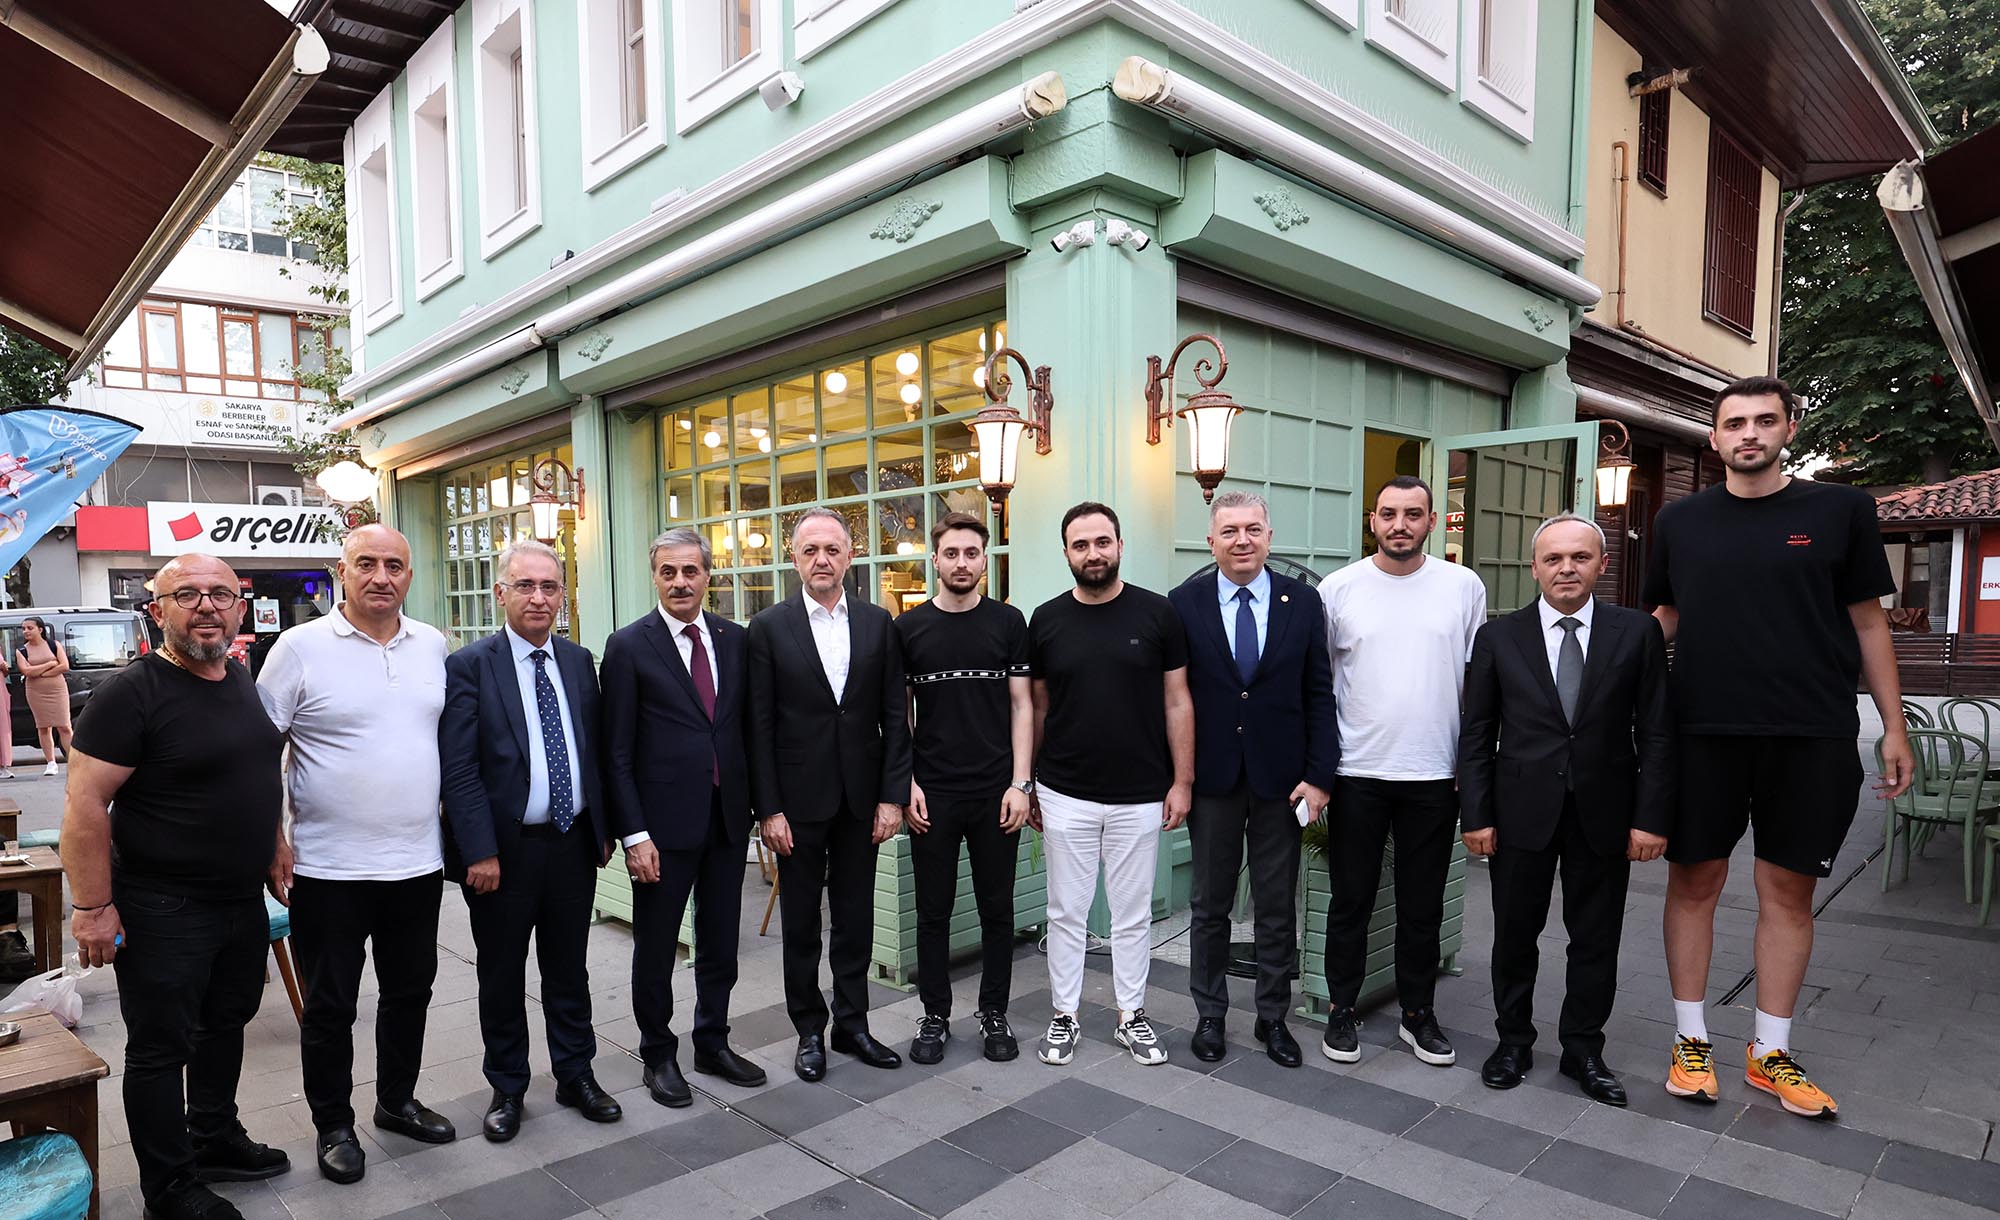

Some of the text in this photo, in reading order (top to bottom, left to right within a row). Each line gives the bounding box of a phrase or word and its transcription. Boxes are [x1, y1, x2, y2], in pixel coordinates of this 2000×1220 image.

[225, 402, 262, 411] SAKARYA
[222, 412, 266, 421] BERBERLER
[195, 420, 223, 428] ESNAF
[207, 430, 233, 439] ODASI
